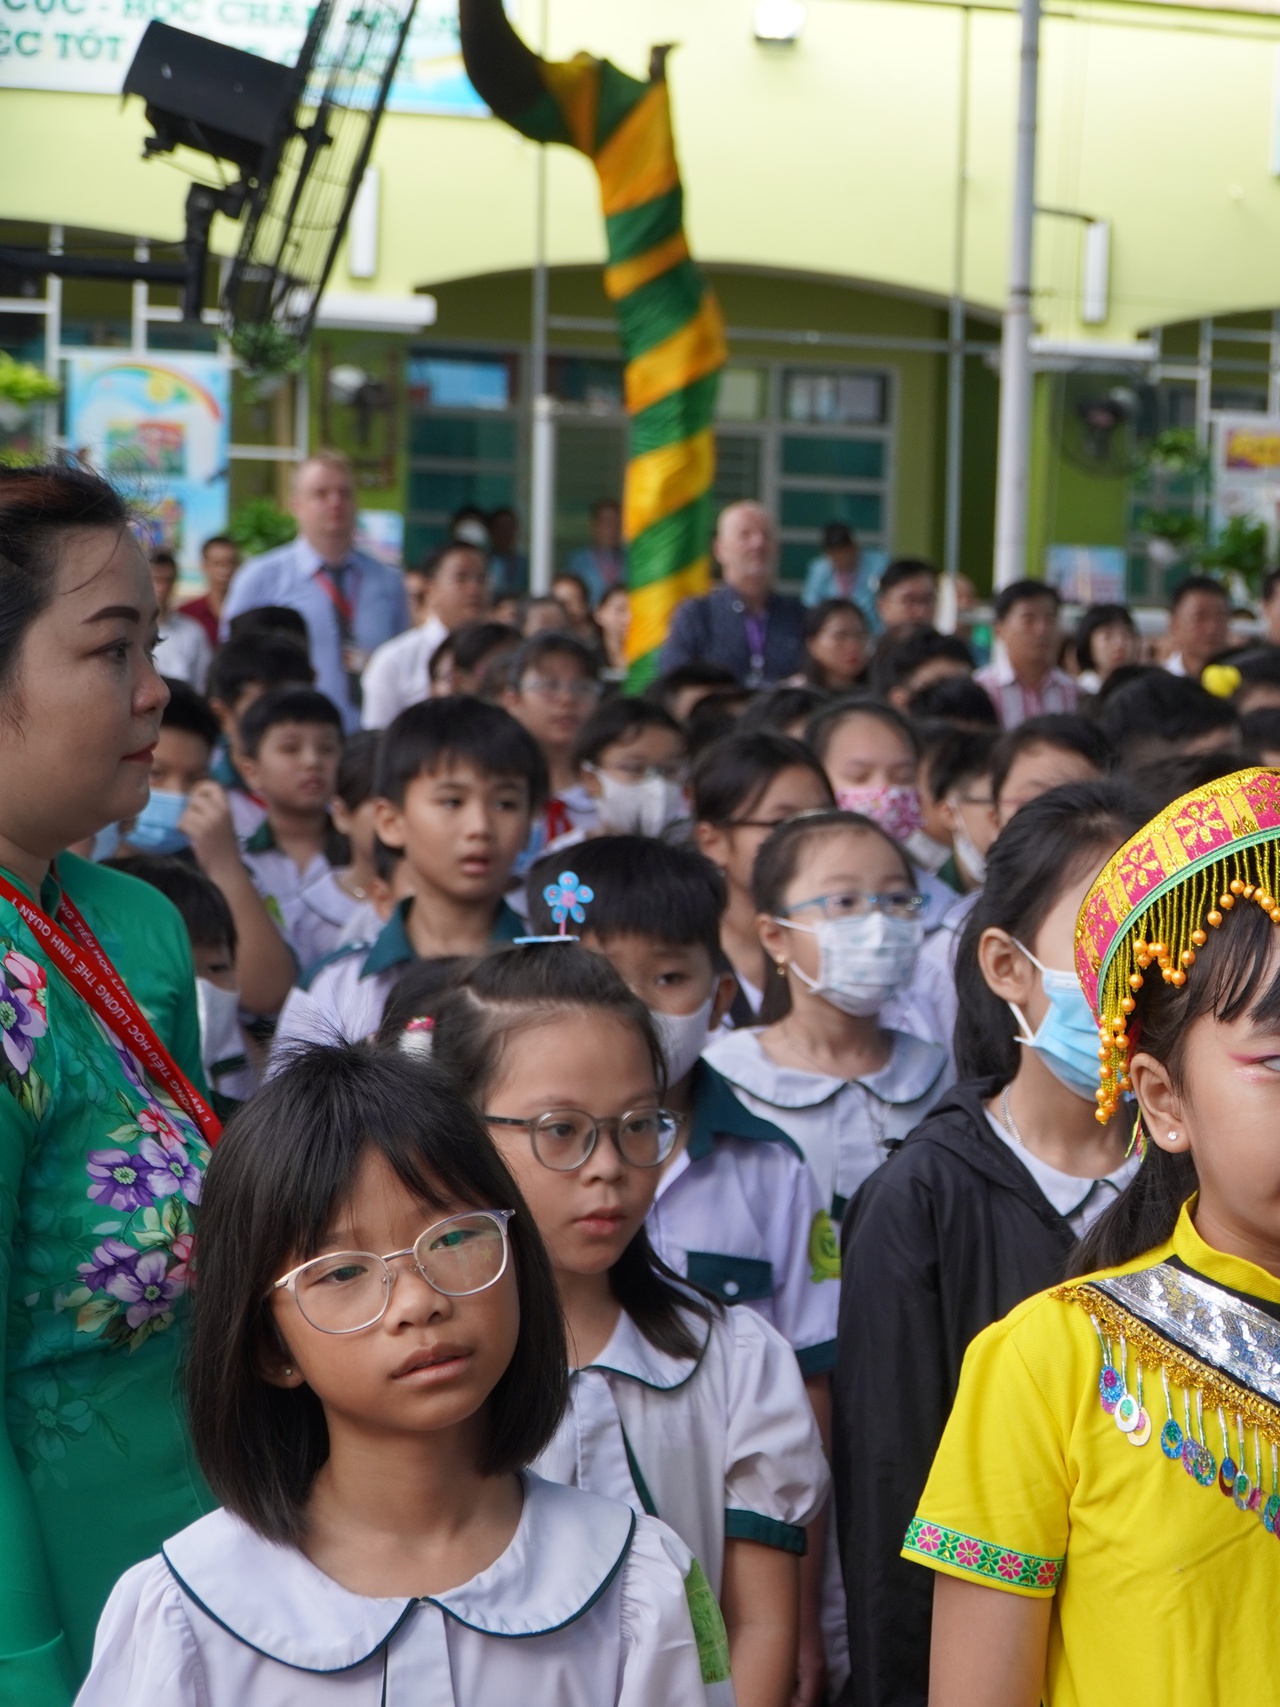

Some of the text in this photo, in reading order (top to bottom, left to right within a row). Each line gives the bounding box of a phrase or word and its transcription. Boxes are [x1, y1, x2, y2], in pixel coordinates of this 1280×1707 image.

[19, 904, 52, 937] QUẬN
[50, 934, 77, 965] VINH
[92, 949, 113, 976] HỌC
[71, 959, 98, 988] THẾ
[94, 983, 132, 1026] LƯƠNG
[127, 1024, 152, 1052] HỌC
[147, 1051, 171, 1080] TIỂU
